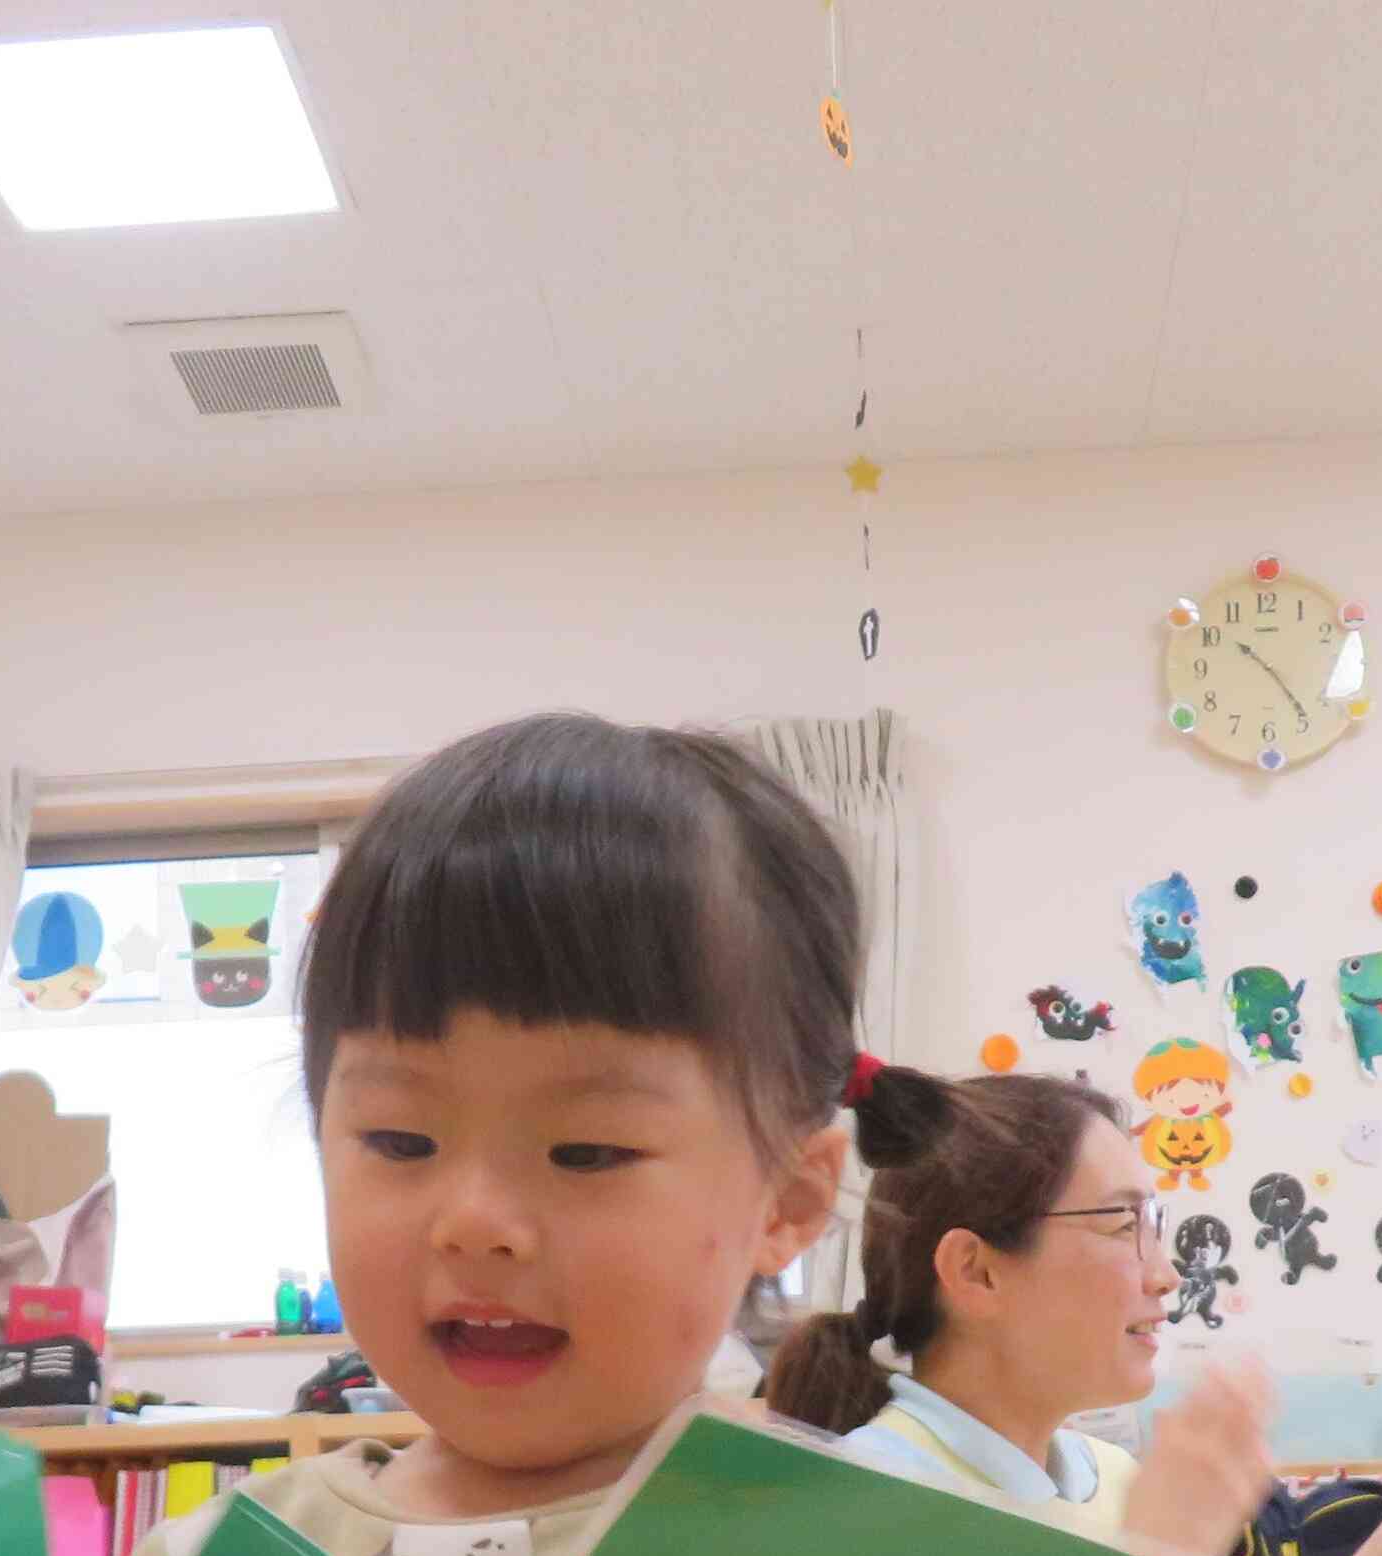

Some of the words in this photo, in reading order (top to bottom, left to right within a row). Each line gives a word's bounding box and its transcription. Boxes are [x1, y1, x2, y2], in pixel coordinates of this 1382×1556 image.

[1225, 602, 1240, 624] 11
[1257, 592, 1277, 614] 12
[1296, 600, 1304, 621] 1
[1202, 626, 1220, 647] 10
[1319, 623, 1332, 643] 2
[1194, 659, 1207, 680] 9
[1204, 692, 1217, 712] 8
[1229, 715, 1241, 736] 7
[1262, 722, 1276, 741] 6
[1297, 715, 1309, 733] 5
